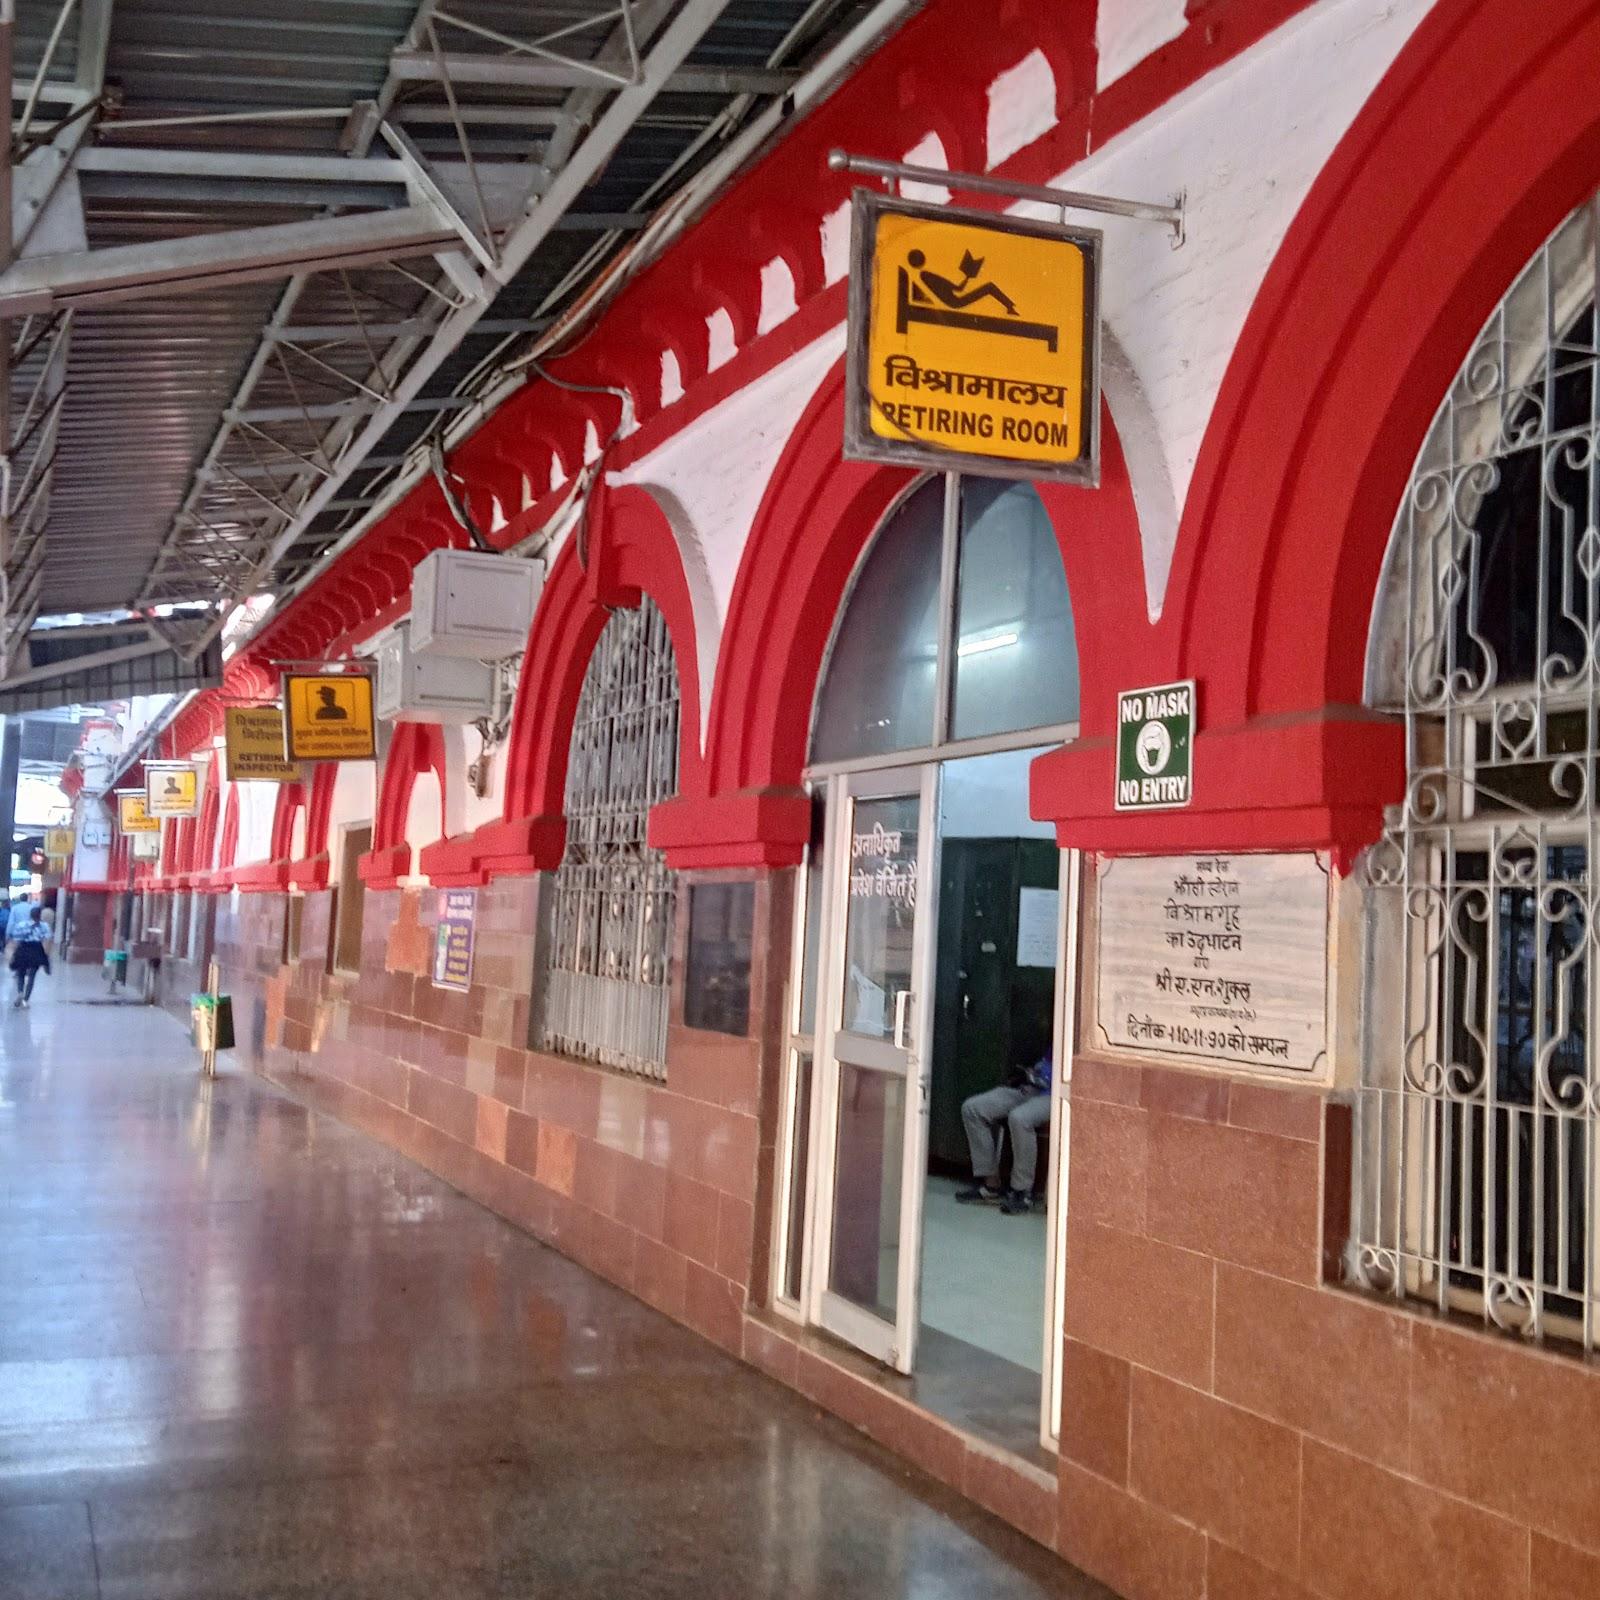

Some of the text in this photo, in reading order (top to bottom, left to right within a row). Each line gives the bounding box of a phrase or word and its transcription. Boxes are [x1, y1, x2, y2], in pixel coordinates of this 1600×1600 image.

[883, 354, 1068, 409] विश्रामालय
[881, 401, 1069, 448] RETIRING ROOM
[1121, 691, 1189, 723] NO MASK
[1120, 775, 1187, 803] NO ENTRY
[1226, 1024, 1247, 1051] को
